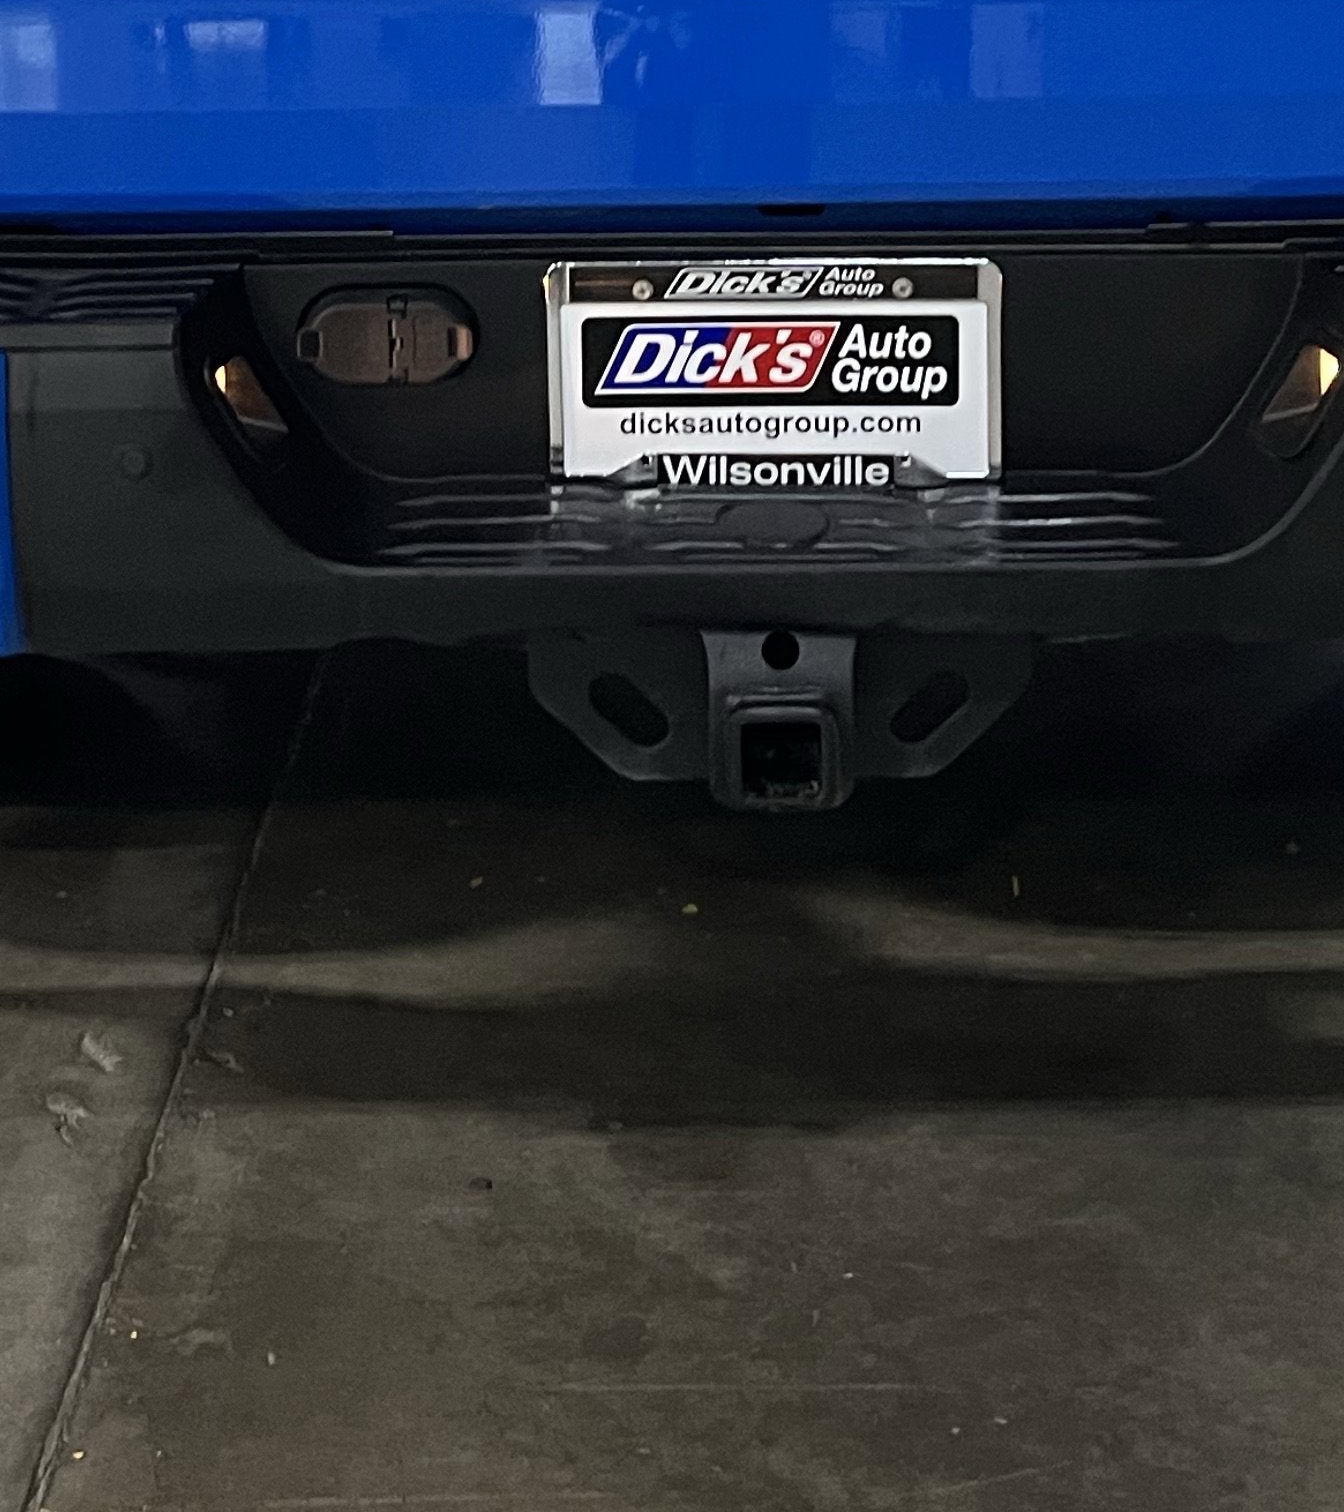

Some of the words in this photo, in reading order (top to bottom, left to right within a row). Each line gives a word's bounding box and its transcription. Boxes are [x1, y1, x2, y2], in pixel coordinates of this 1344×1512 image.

[675, 269, 811, 296] Dick's
[825, 267, 876, 281] Auto
[818, 280, 884, 298] Group
[613, 329, 814, 384] Dick's
[838, 324, 932, 359] Auto
[831, 358, 949, 400] Group
[620, 412, 922, 439] dicksautogroup.com
[663, 455, 890, 486] Wilsonville
